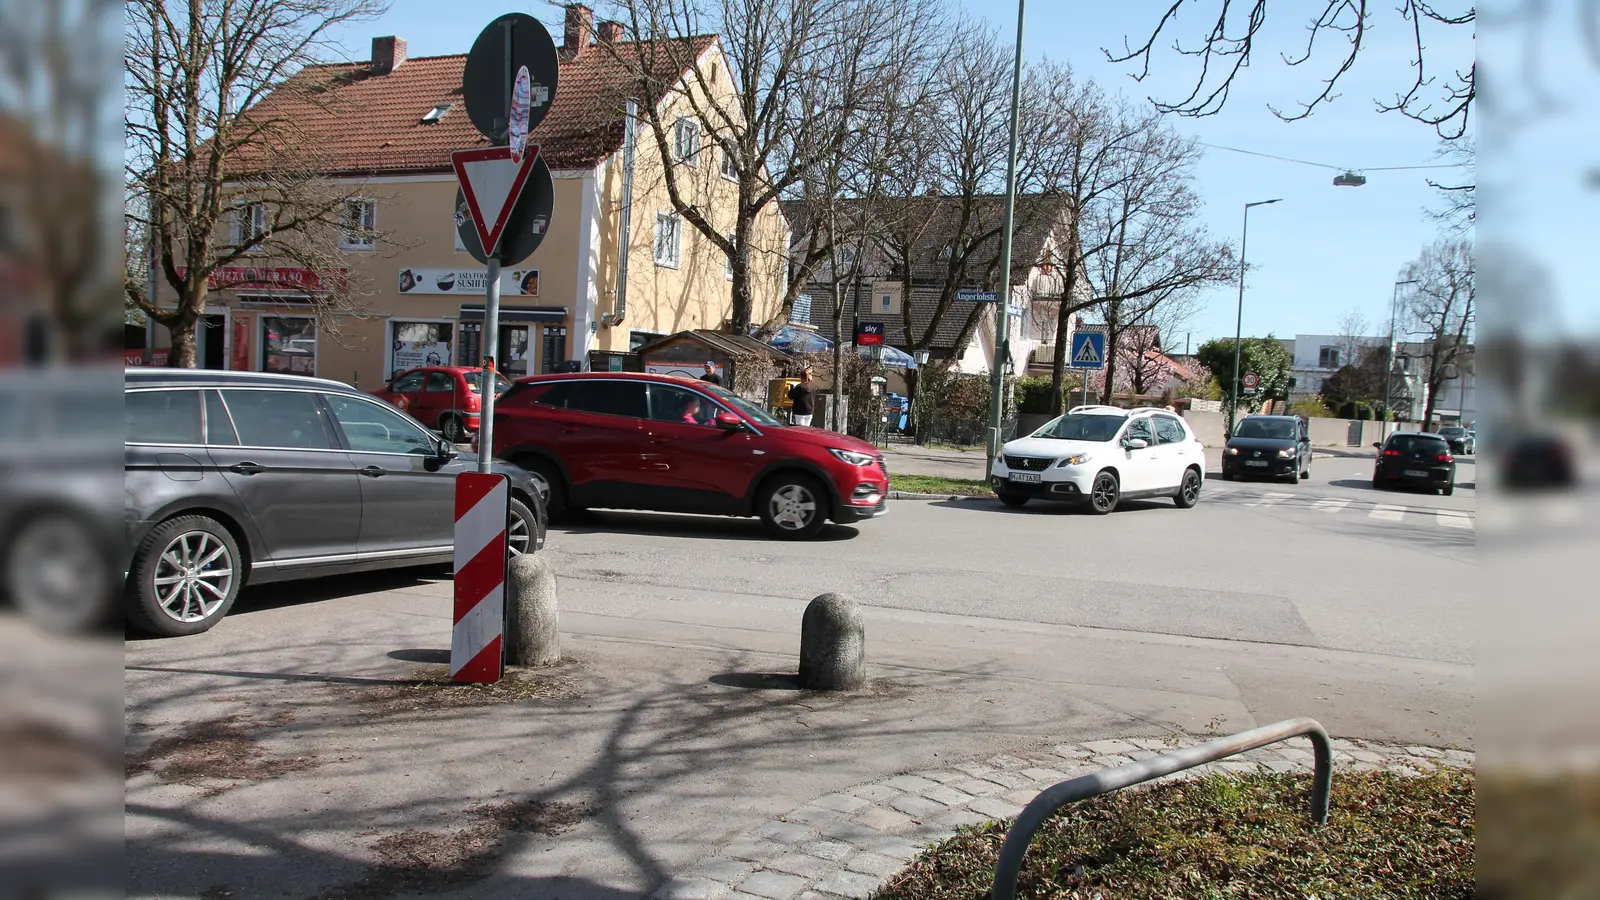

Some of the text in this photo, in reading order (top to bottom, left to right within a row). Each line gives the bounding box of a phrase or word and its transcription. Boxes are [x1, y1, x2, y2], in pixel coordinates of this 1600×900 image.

[215, 269, 303, 282] PIZZA MURANO
[459, 272, 472, 280] ASIA
[457, 279, 480, 288] SUSHI
[956, 291, 996, 301] Angerlohstr.
[864, 325, 877, 333] sky
[1246, 376, 1255, 384] 30
